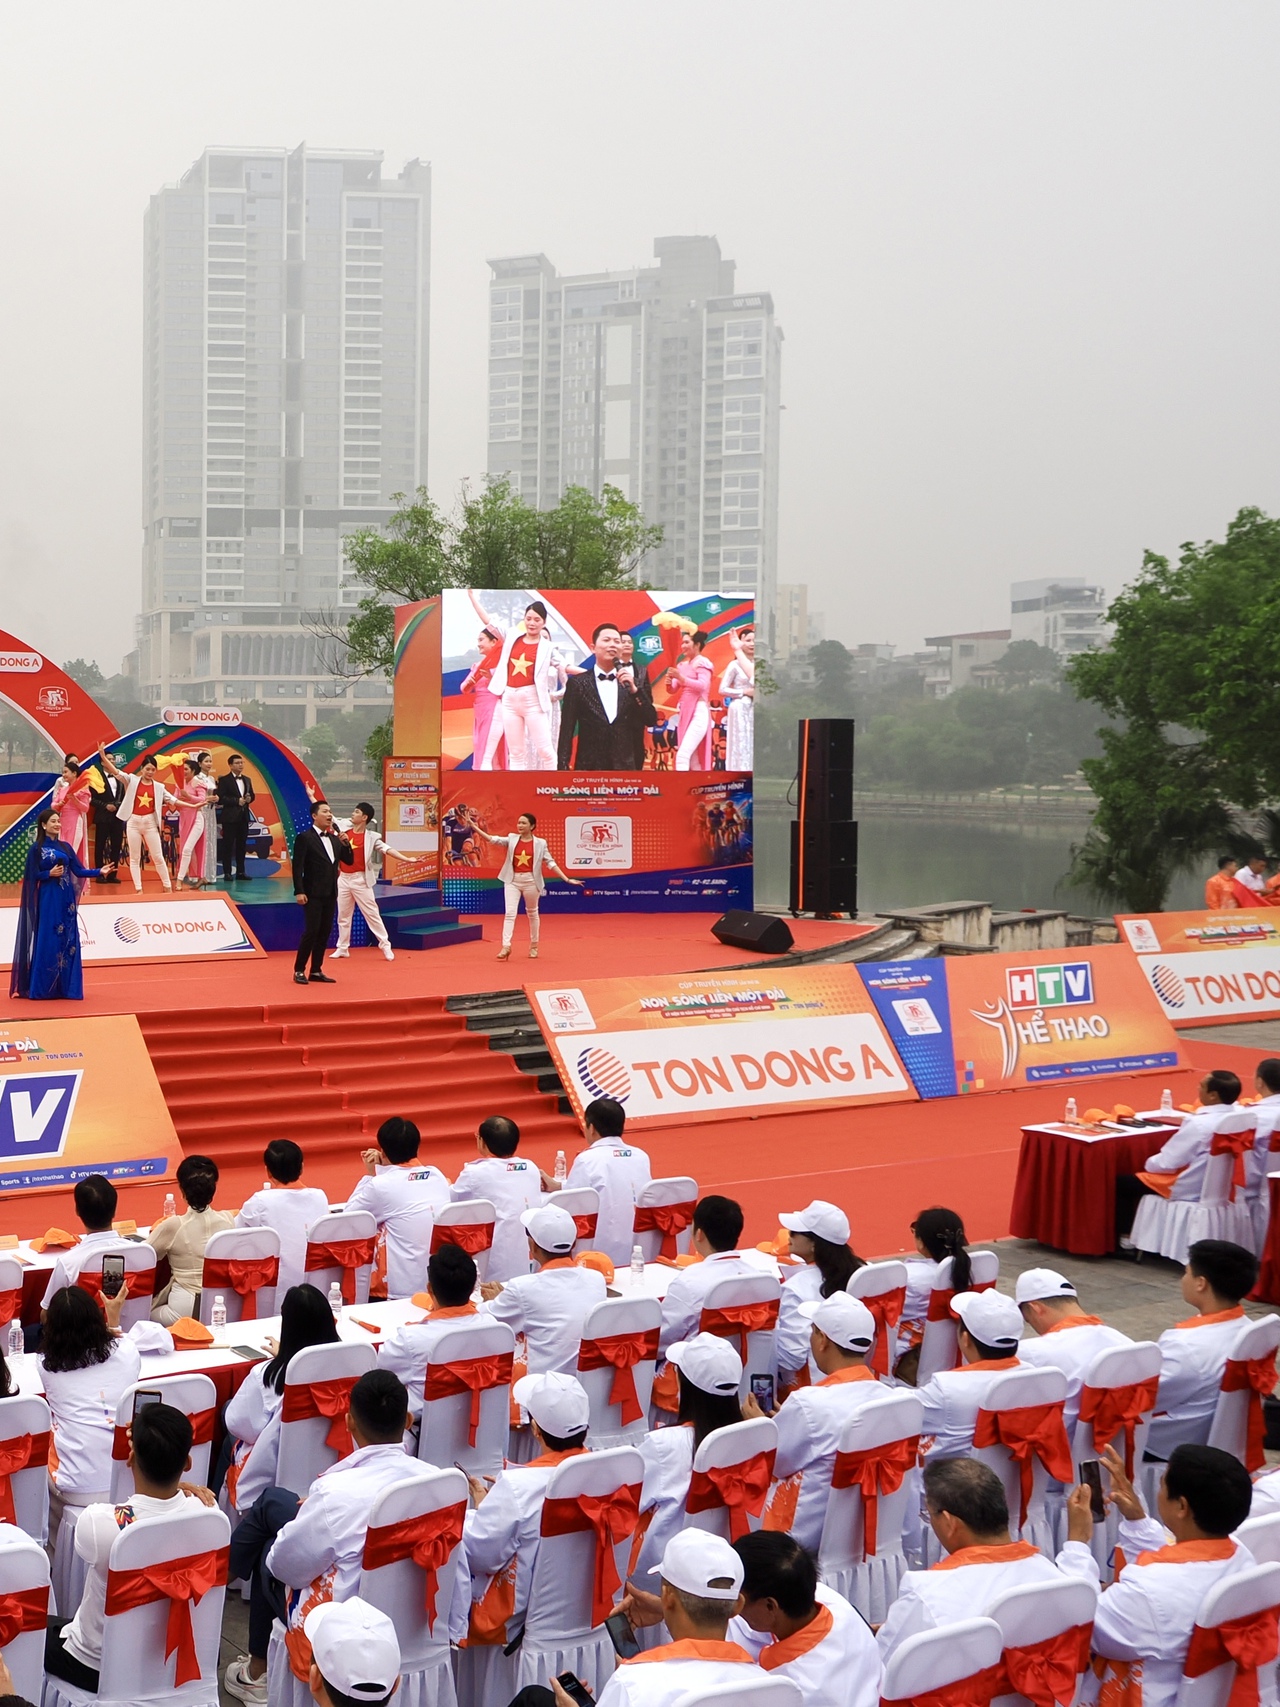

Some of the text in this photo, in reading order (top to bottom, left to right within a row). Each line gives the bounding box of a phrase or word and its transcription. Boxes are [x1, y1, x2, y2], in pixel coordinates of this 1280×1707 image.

[0, 657, 30, 668] DONG
[32, 658, 40, 668] A
[176, 712, 240, 722] TON DONG A
[536, 786, 558, 794] NON
[563, 785, 590, 795] SÔNG
[617, 785, 640, 796] MỘT
[142, 920, 226, 936] TON DONG A
[1010, 969, 1086, 1002] HTV
[1184, 970, 1280, 1006] TON DO
[640, 998, 670, 1008] NON
[672, 993, 708, 1006] SÔNG
[737, 989, 762, 1004] MỘT
[1049, 1014, 1109, 1040] THAO
[15, 1036, 38, 1052] DẢI
[632, 1044, 894, 1100] TON DONG A
[507, 1163, 527, 1171] HTV
[1, 1178, 20, 1188] Sports
[409, 1172, 429, 1180] HTV
